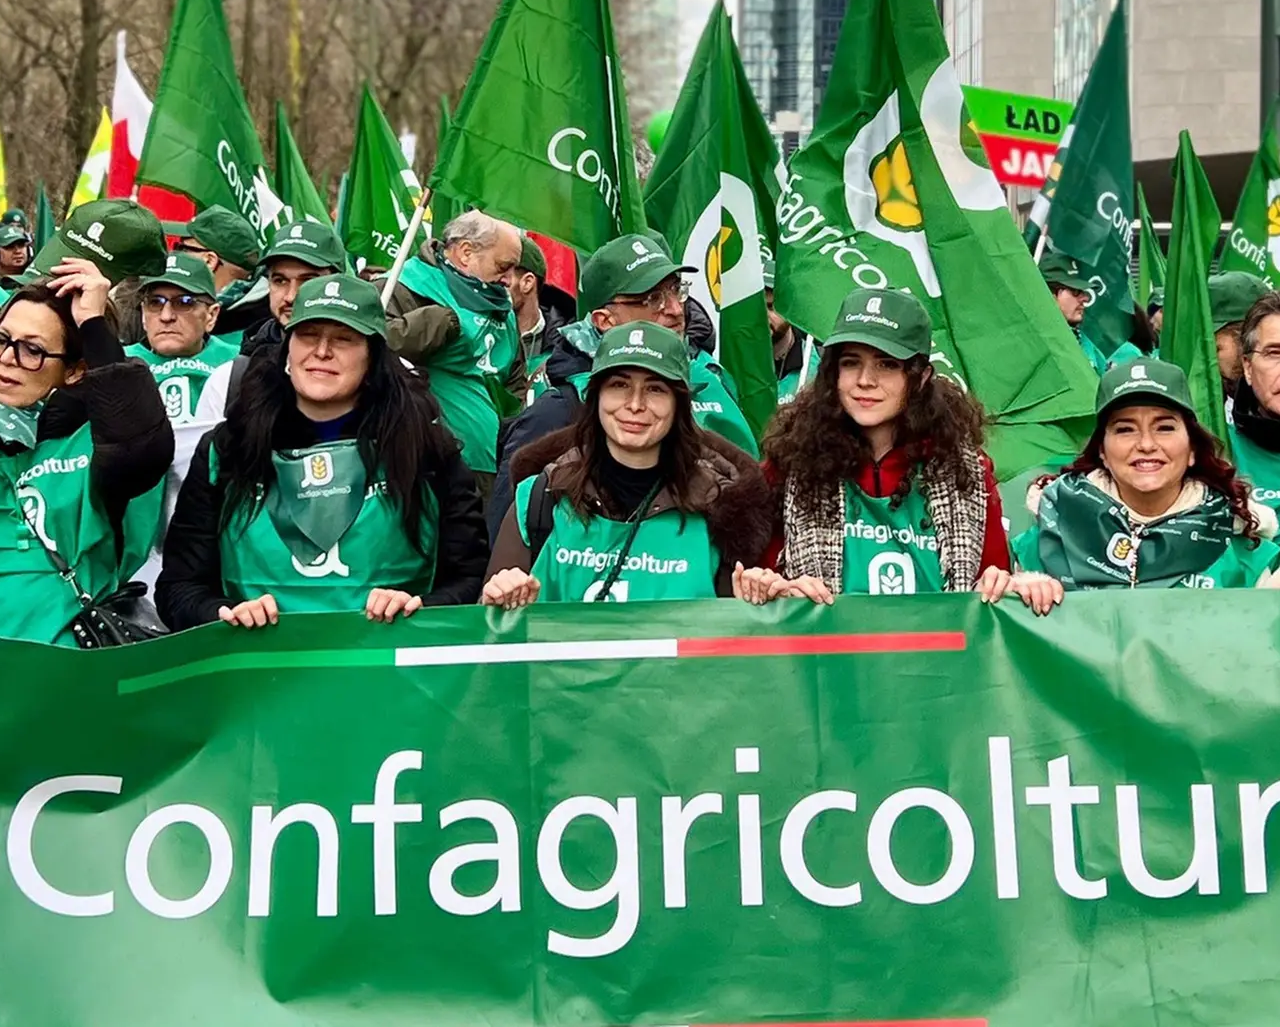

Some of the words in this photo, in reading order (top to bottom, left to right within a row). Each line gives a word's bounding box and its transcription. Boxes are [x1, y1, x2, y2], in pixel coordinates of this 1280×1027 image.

[1005, 104, 1061, 135] ŁAD
[845, 313, 900, 330] Confagricoltura
[609, 345, 663, 360] Confagricoltura
